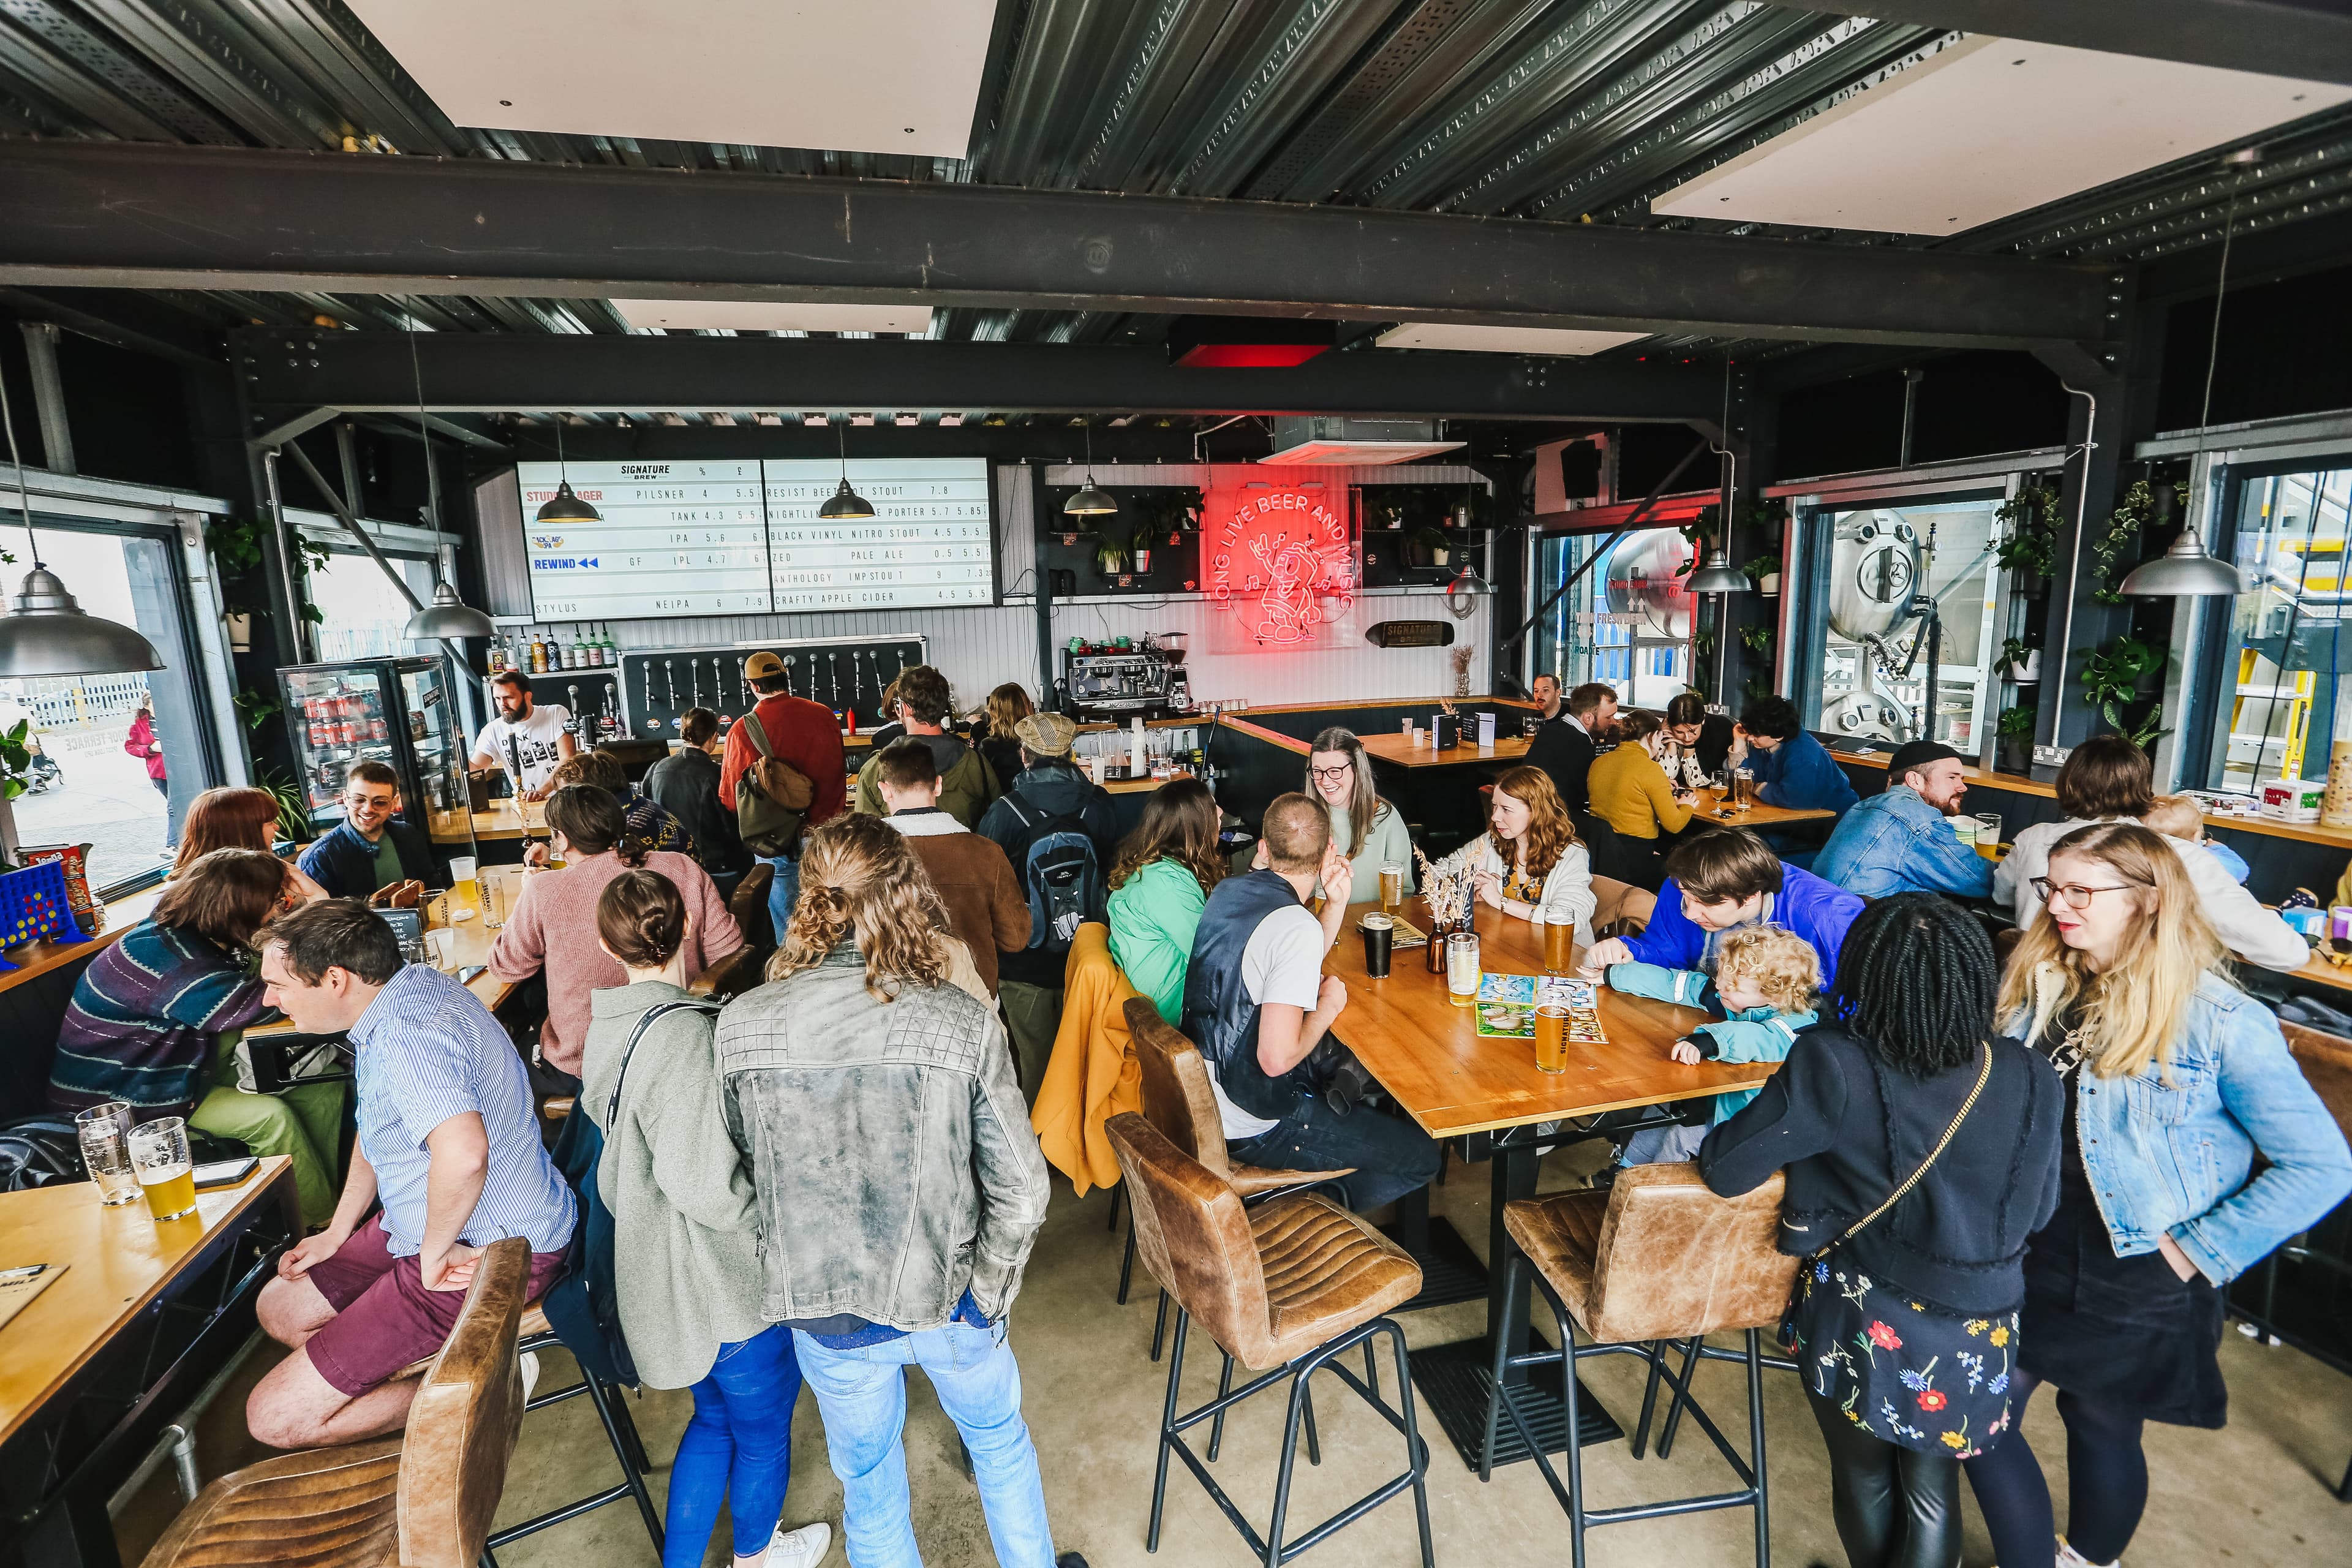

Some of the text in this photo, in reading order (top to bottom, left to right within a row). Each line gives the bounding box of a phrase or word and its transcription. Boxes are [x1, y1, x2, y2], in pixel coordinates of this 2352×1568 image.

[621, 465, 670, 474] SIGNATURE
[699, 467, 742, 476] % £
[527, 491, 559, 501] STUDI
[576, 490, 603, 500] AGER
[636, 489, 684, 499] PILSNER
[703, 489, 707, 498] 4
[736, 489, 754, 497] 5.5
[767, 488, 805, 497] RESIST
[813, 487, 864, 497] BEETOT
[873, 486, 903, 496] STOUT
[672, 511, 696, 521] TANK
[705, 511, 723, 520] 4.3
[738, 510, 755, 520] 5.5
[769, 510, 821, 519] NIGHTLIN
[888, 507, 925, 517] PORTER
[932, 507, 949, 516] 5.7
[957, 506, 981, 515] 5.85
[670, 533, 688, 543] IPA
[706, 533, 725, 542] 5.6
[753, 533, 757, 542] 6
[771, 530, 803, 540] BLACK
[811, 530, 842, 540] VINYL
[852, 529, 882, 539] NITRO
[890, 528, 920, 538] STOUT
[934, 527, 951, 537] 4.5
[962, 527, 979, 536] 5.5
[773, 552, 791, 562] ZED
[851, 551, 873, 560] PALE
[885, 549, 903, 559] ALE
[935, 549, 951, 558] 0.5
[963, 548, 981, 557] 5.5
[1215, 493, 1355, 610] LONG LIVE BEER AND MUSIC
[534, 558, 575, 570] REWIND
[630, 557, 641, 566] GF
[673, 556, 690, 565] IPL
[707, 554, 725, 564] 4.7
[755, 554, 758, 563] 6
[774, 573, 832, 583] ANTHOLOGY
[937, 570, 941, 579] 9
[967, 568, 982, 578] 7.3
[775, 595, 813, 605] CRAFTY
[821, 592, 853, 603] APPLE
[862, 592, 894, 602] CIDER
[938, 590, 956, 600] 4.5
[968, 589, 985, 598] 5.5
[536, 603, 577, 613] STYLUS
[656, 599, 690, 609] NEIPA
[717, 598, 722, 608] 6
[745, 597, 762, 606] 7.9
[502, 734, 529, 747] DNK
[1560, 1012, 1570, 1054] SIGNATURE
